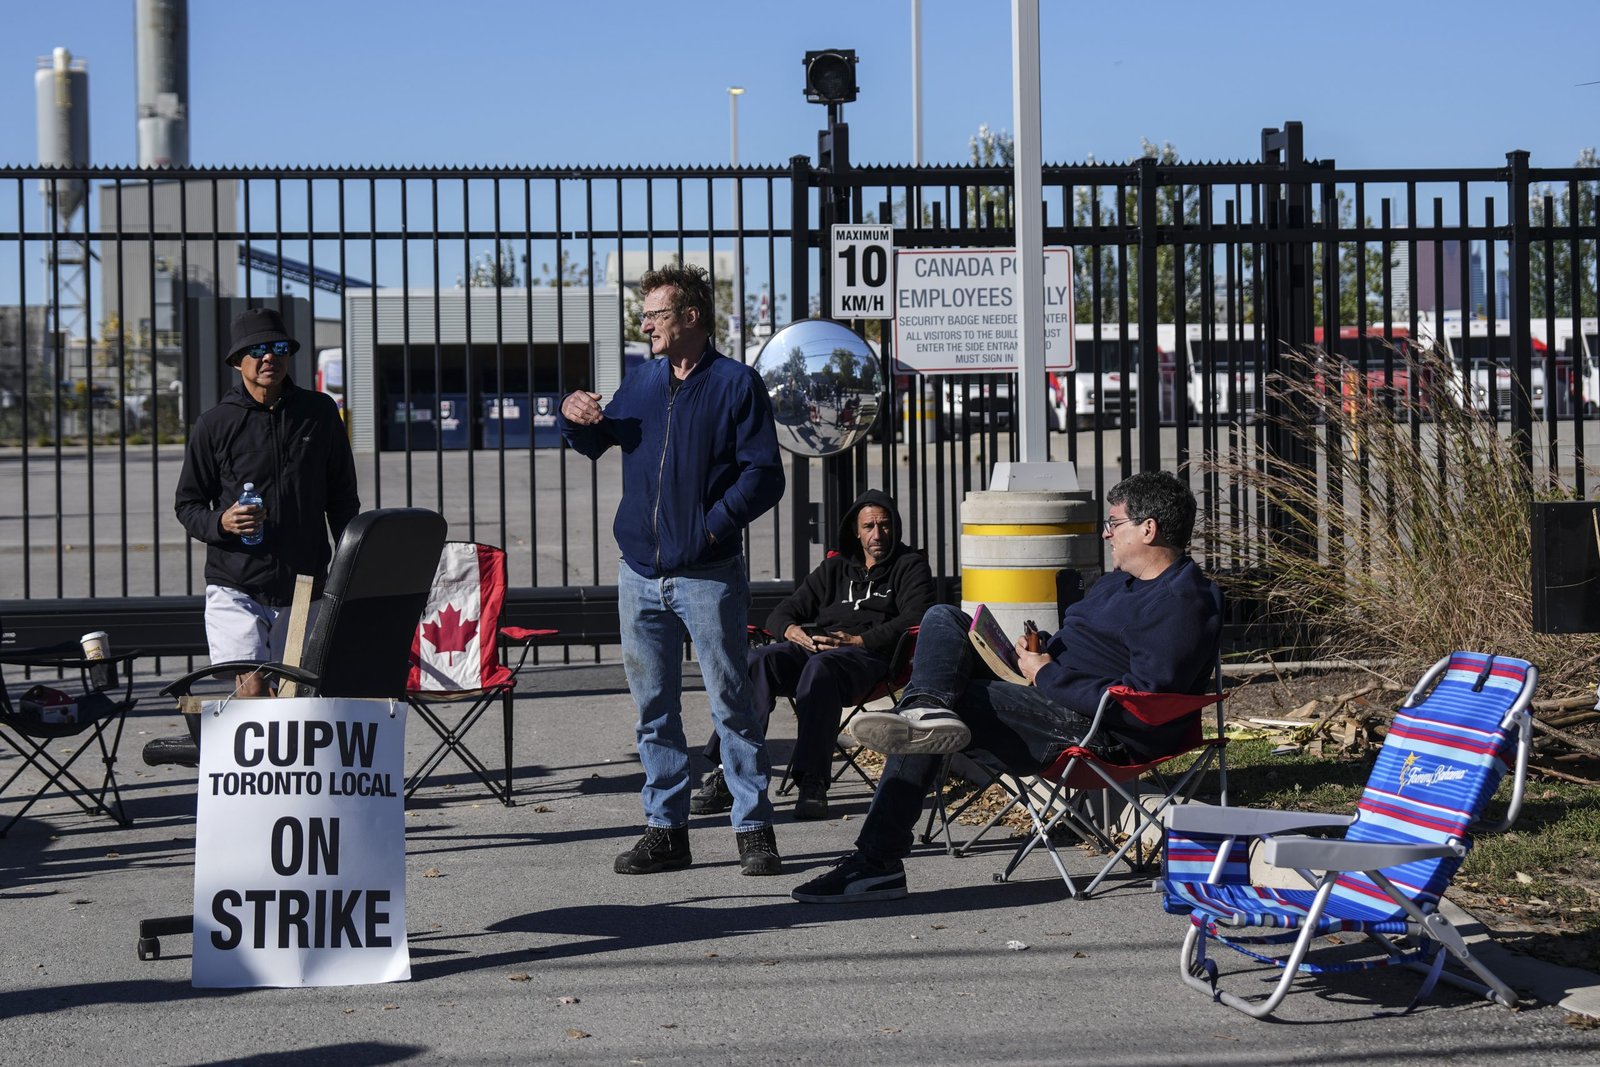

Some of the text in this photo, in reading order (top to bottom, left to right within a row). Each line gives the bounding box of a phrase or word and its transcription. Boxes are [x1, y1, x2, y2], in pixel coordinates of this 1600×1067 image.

[836, 230, 889, 241] MAXIMUM
[838, 244, 887, 288] 10
[914, 256, 1050, 278] CANADA PT
[842, 294, 884, 311] KM/H
[899, 286, 1013, 308] EMPLOYEES
[899, 315, 945, 326] SECURITY
[948, 315, 980, 325] BADGE
[1044, 313, 1068, 323] NTER
[906, 332, 922, 340] ALL
[924, 331, 962, 340] VISITORS
[963, 330, 975, 340] TO
[977, 330, 993, 339] THE
[1044, 329, 1061, 338] UST
[916, 343, 945, 352] ENTER
[946, 342, 962, 352] THE
[965, 342, 984, 351] SIDE
[955, 353, 1014, 364] MUST SIGN IN
[233, 720, 379, 768] CUPW
[209, 771, 397, 797] TORONTO LOCAL
[271, 816, 340, 876] ON
[210, 889, 393, 950] STRIKE
